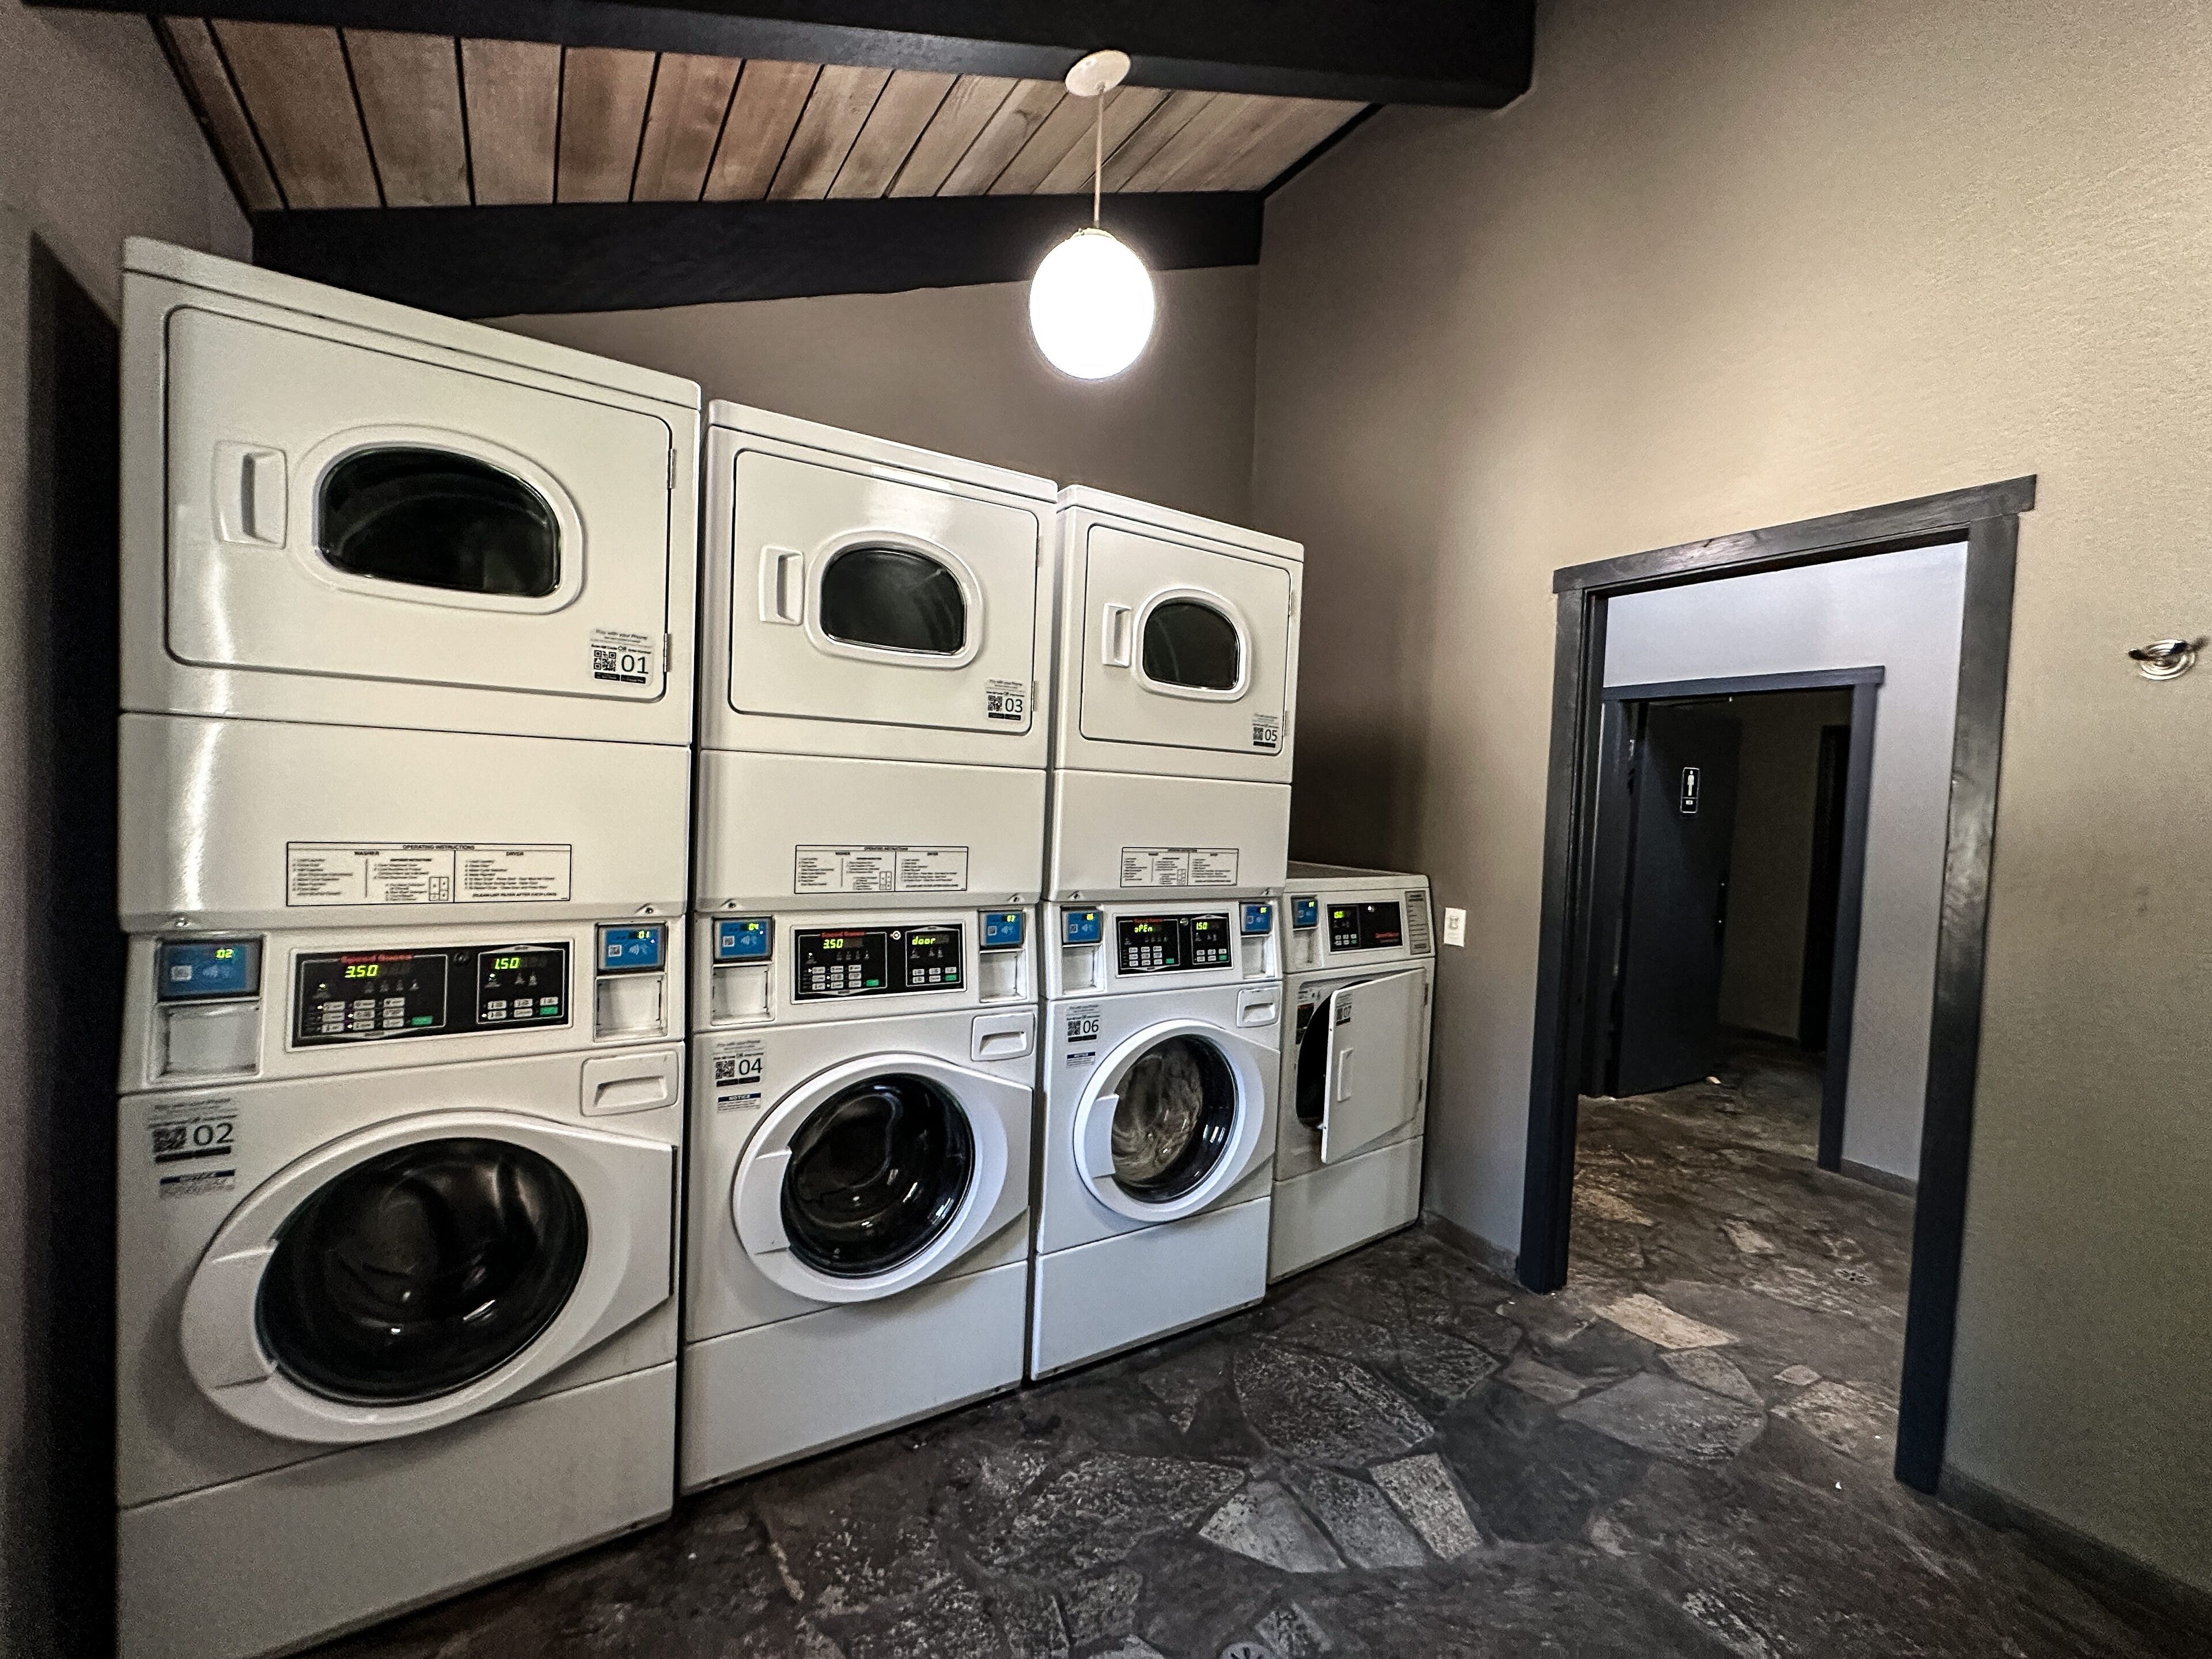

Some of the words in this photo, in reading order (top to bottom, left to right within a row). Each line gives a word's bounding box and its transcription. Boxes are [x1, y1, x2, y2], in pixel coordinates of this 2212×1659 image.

[621, 654, 649, 674] 01
[1005, 698, 1023, 713] 03
[1264, 729, 1277, 741] 05
[1083, 1019, 1099, 1033] 06
[738, 1058, 763, 1075] 04
[193, 1123, 235, 1146] 02
